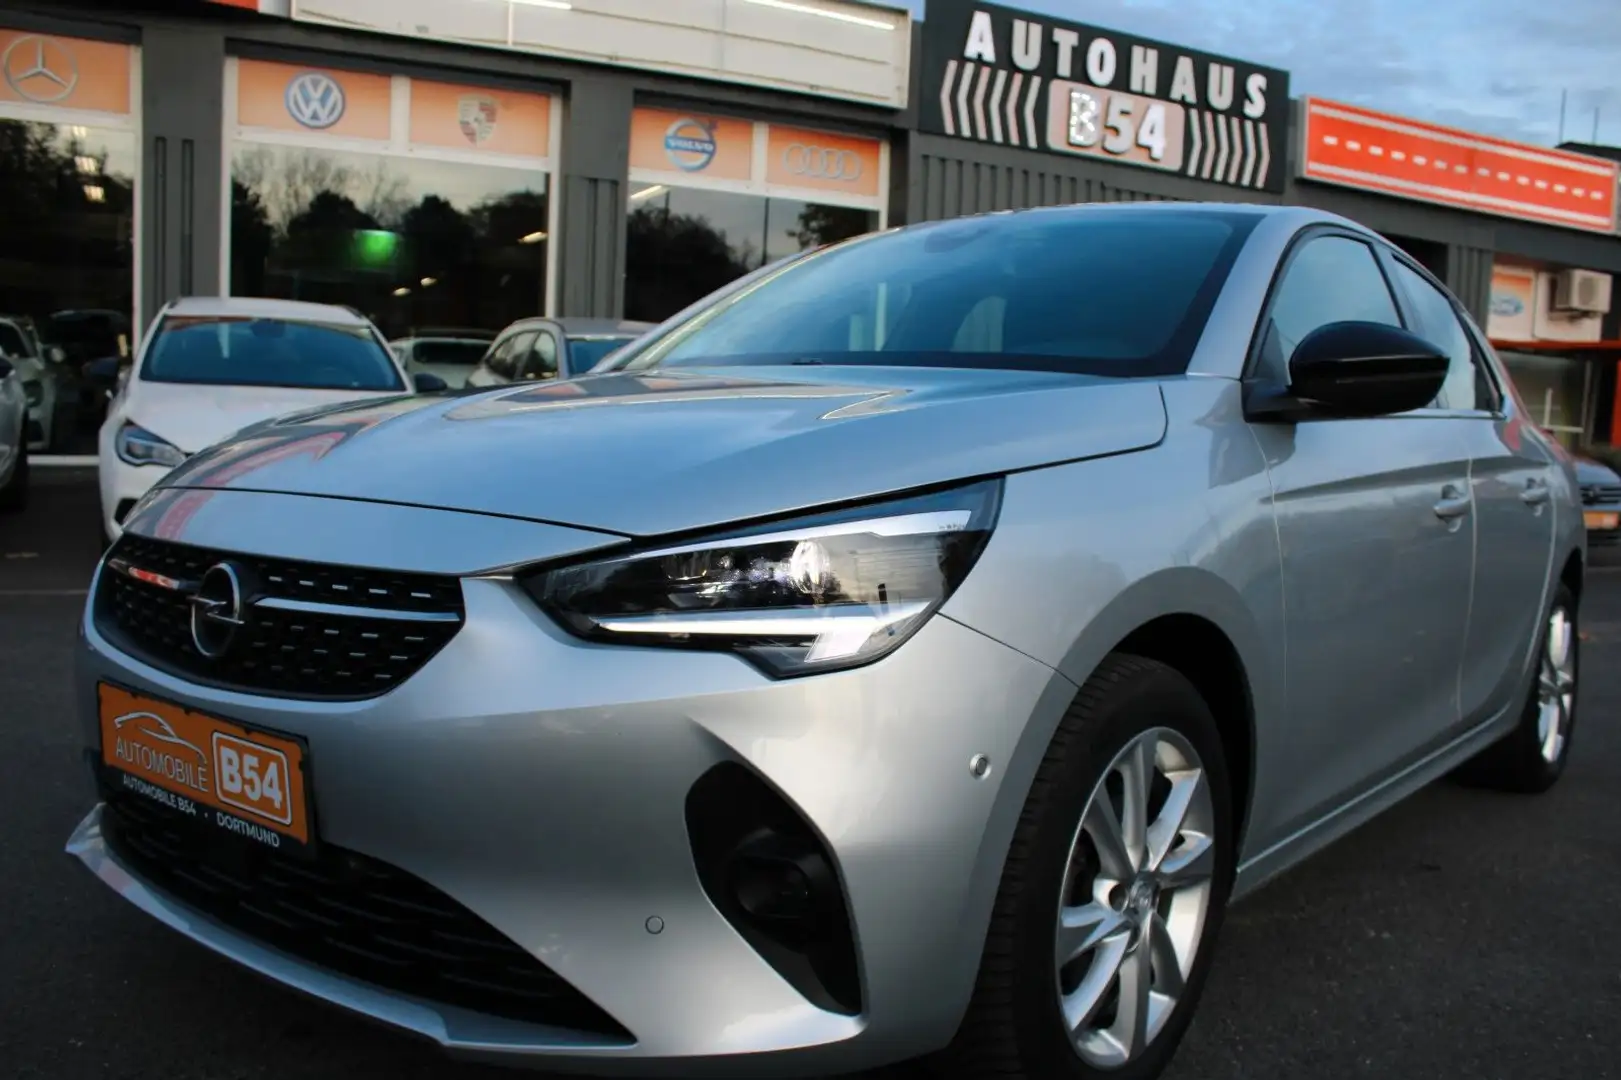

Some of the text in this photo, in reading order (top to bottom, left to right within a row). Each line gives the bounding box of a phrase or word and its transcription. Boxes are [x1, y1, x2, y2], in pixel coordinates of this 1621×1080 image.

[963, 10, 1267, 119] AUTOHAUS
[1068, 88, 1167, 161] B54
[115, 736, 209, 792] AUTOMOBILE
[219, 745, 282, 810] B54
[122, 772, 280, 848] AUTOMOBILE B54 DORTMUND
